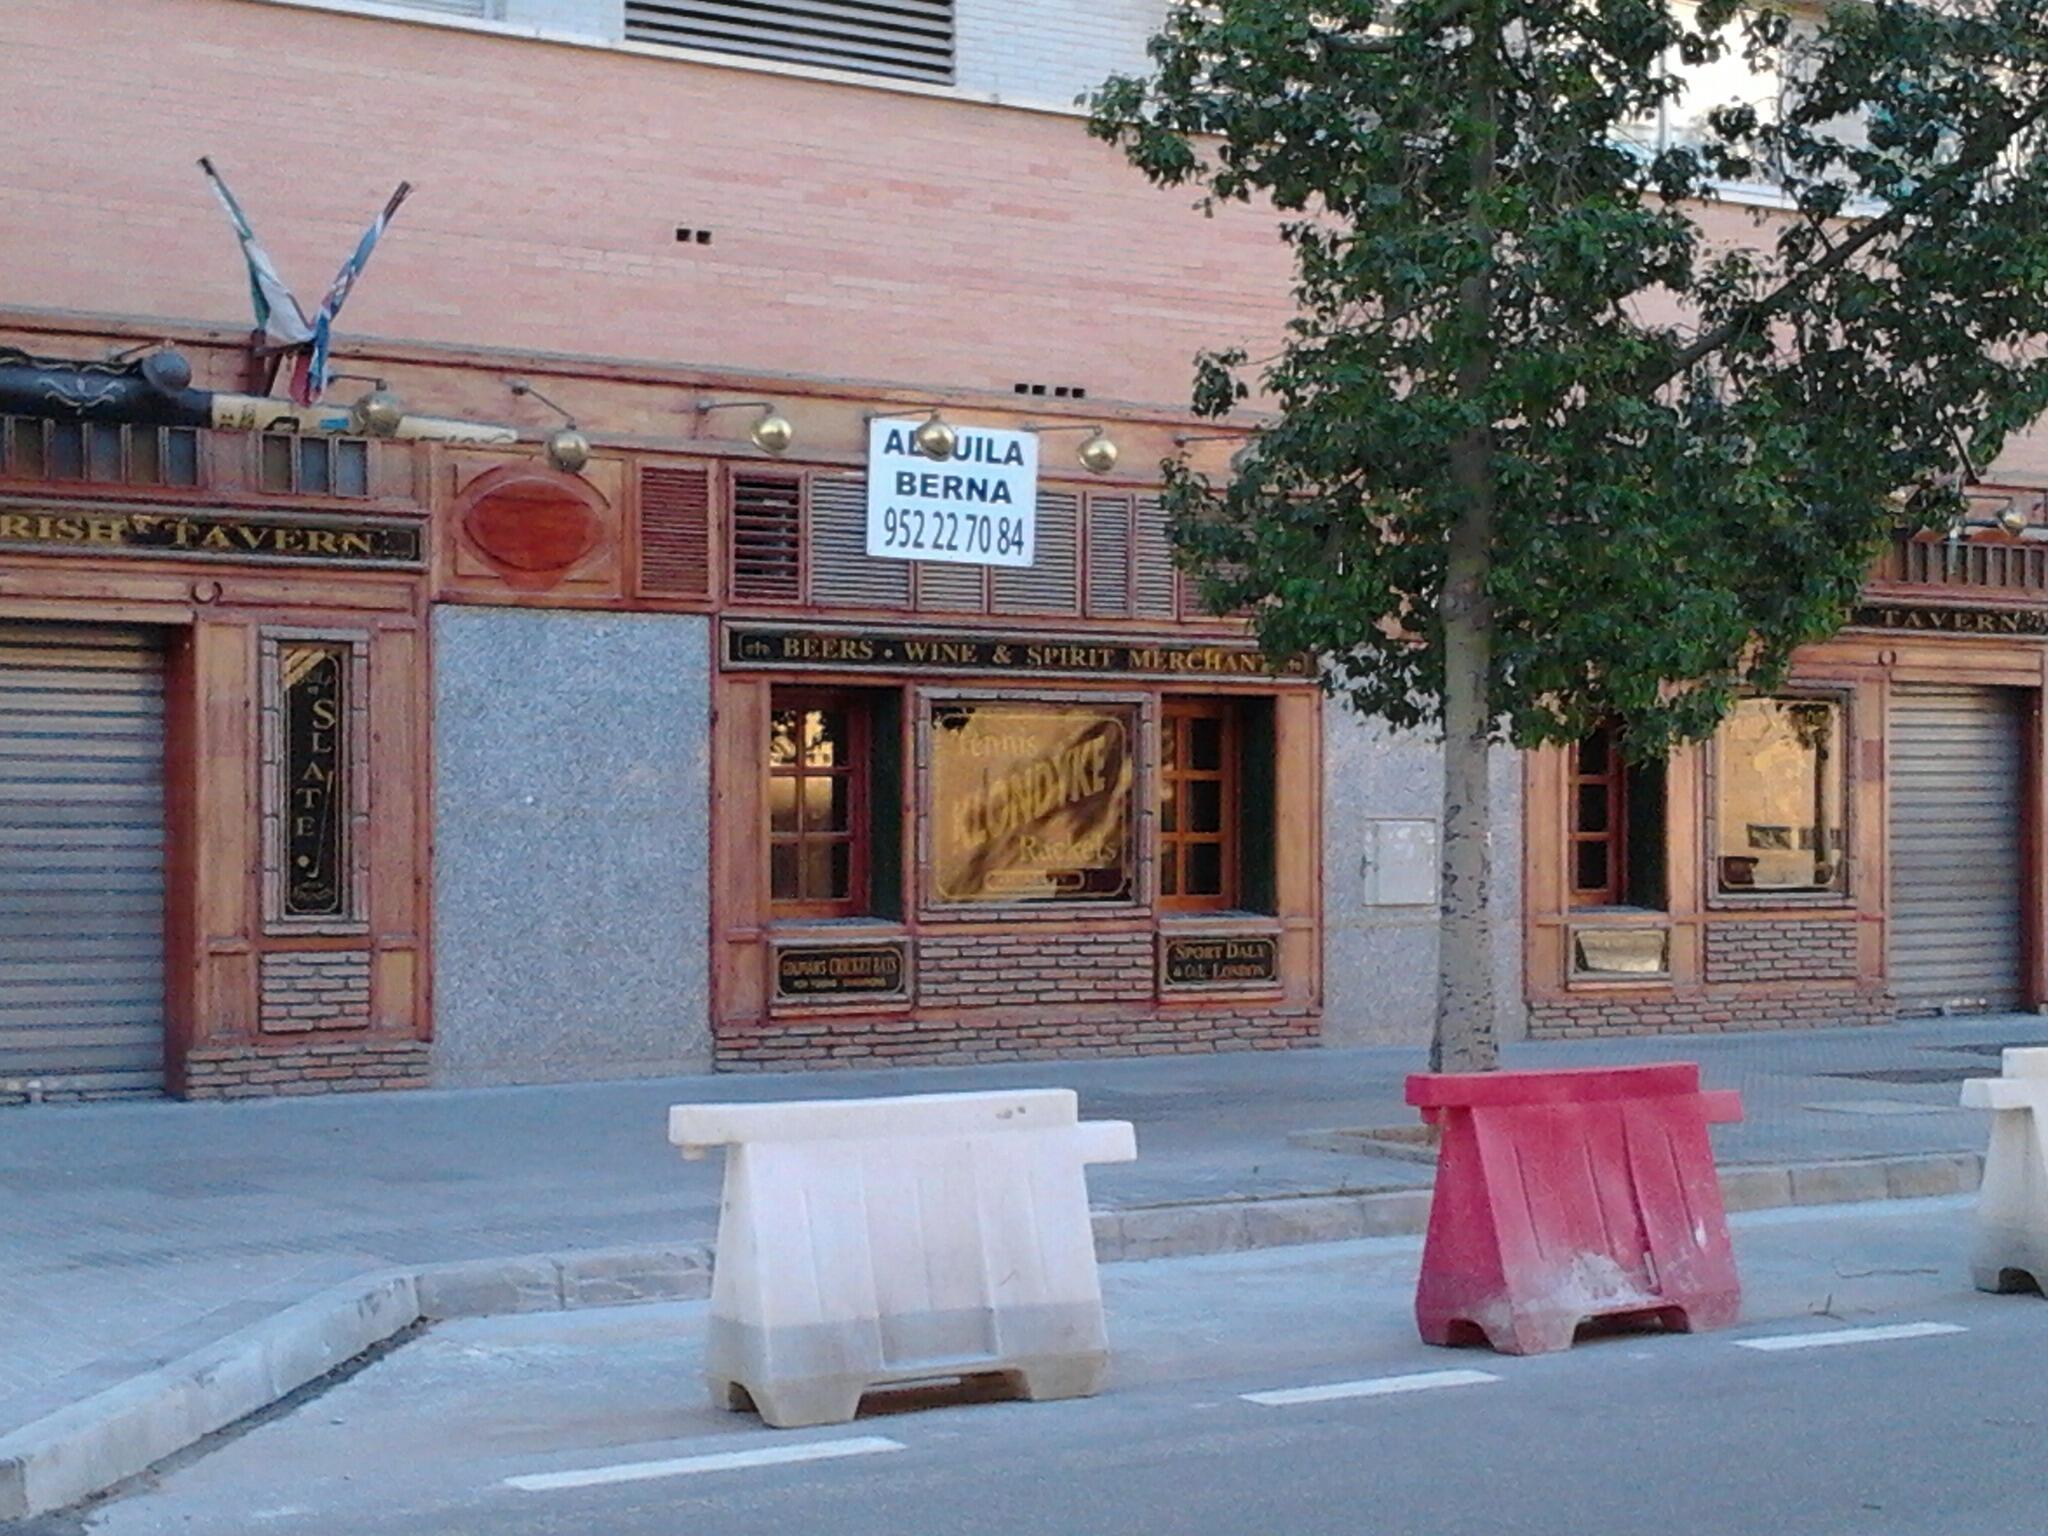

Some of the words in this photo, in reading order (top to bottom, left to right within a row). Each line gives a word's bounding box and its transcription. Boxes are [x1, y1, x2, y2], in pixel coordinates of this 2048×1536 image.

[884, 428, 1025, 467] ALUILA
[895, 471, 1013, 504] BERNA
[167, 517, 372, 554] TAVERN
[884, 506, 926, 549] 952
[932, 511, 959, 552] 22
[966, 514, 992, 555] 70
[996, 516, 1025, 557] 84
[1879, 608, 2019, 632] TAVERN
[783, 636, 874, 660] BEERS
[904, 641, 977, 663] WINE
[991, 646, 1012, 665] &
[1026, 645, 1115, 667] SPIRIT
[295, 699, 337, 837] SLATE
